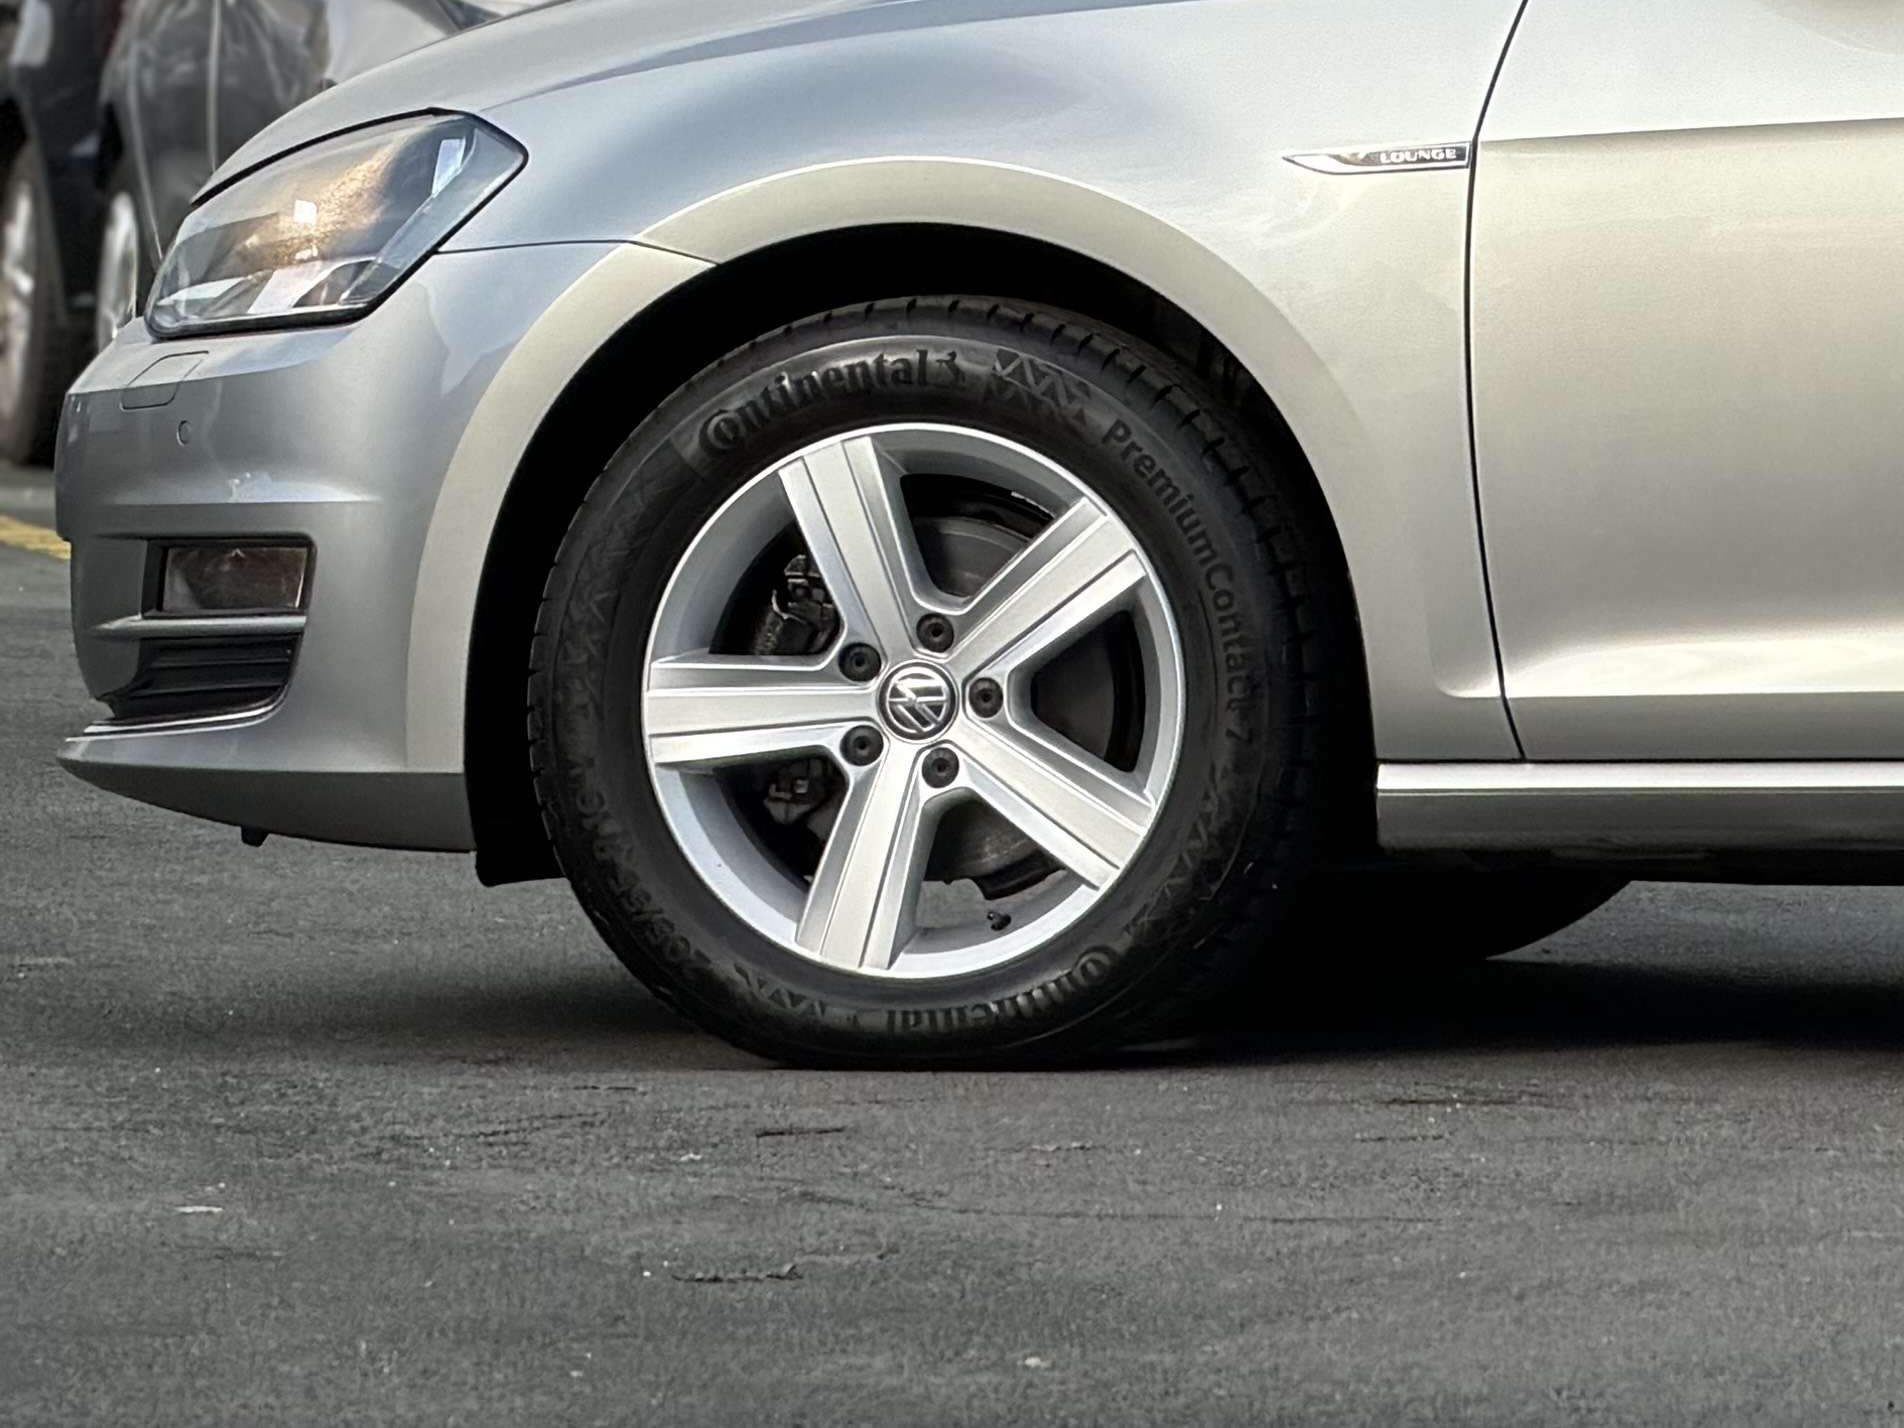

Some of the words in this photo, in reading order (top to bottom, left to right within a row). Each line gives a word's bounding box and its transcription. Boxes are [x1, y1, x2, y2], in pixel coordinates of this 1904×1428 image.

[1380, 149, 1458, 164] LOUNGE
[699, 348, 929, 450] Continental
[1102, 419, 1256, 711] PremiumContact
